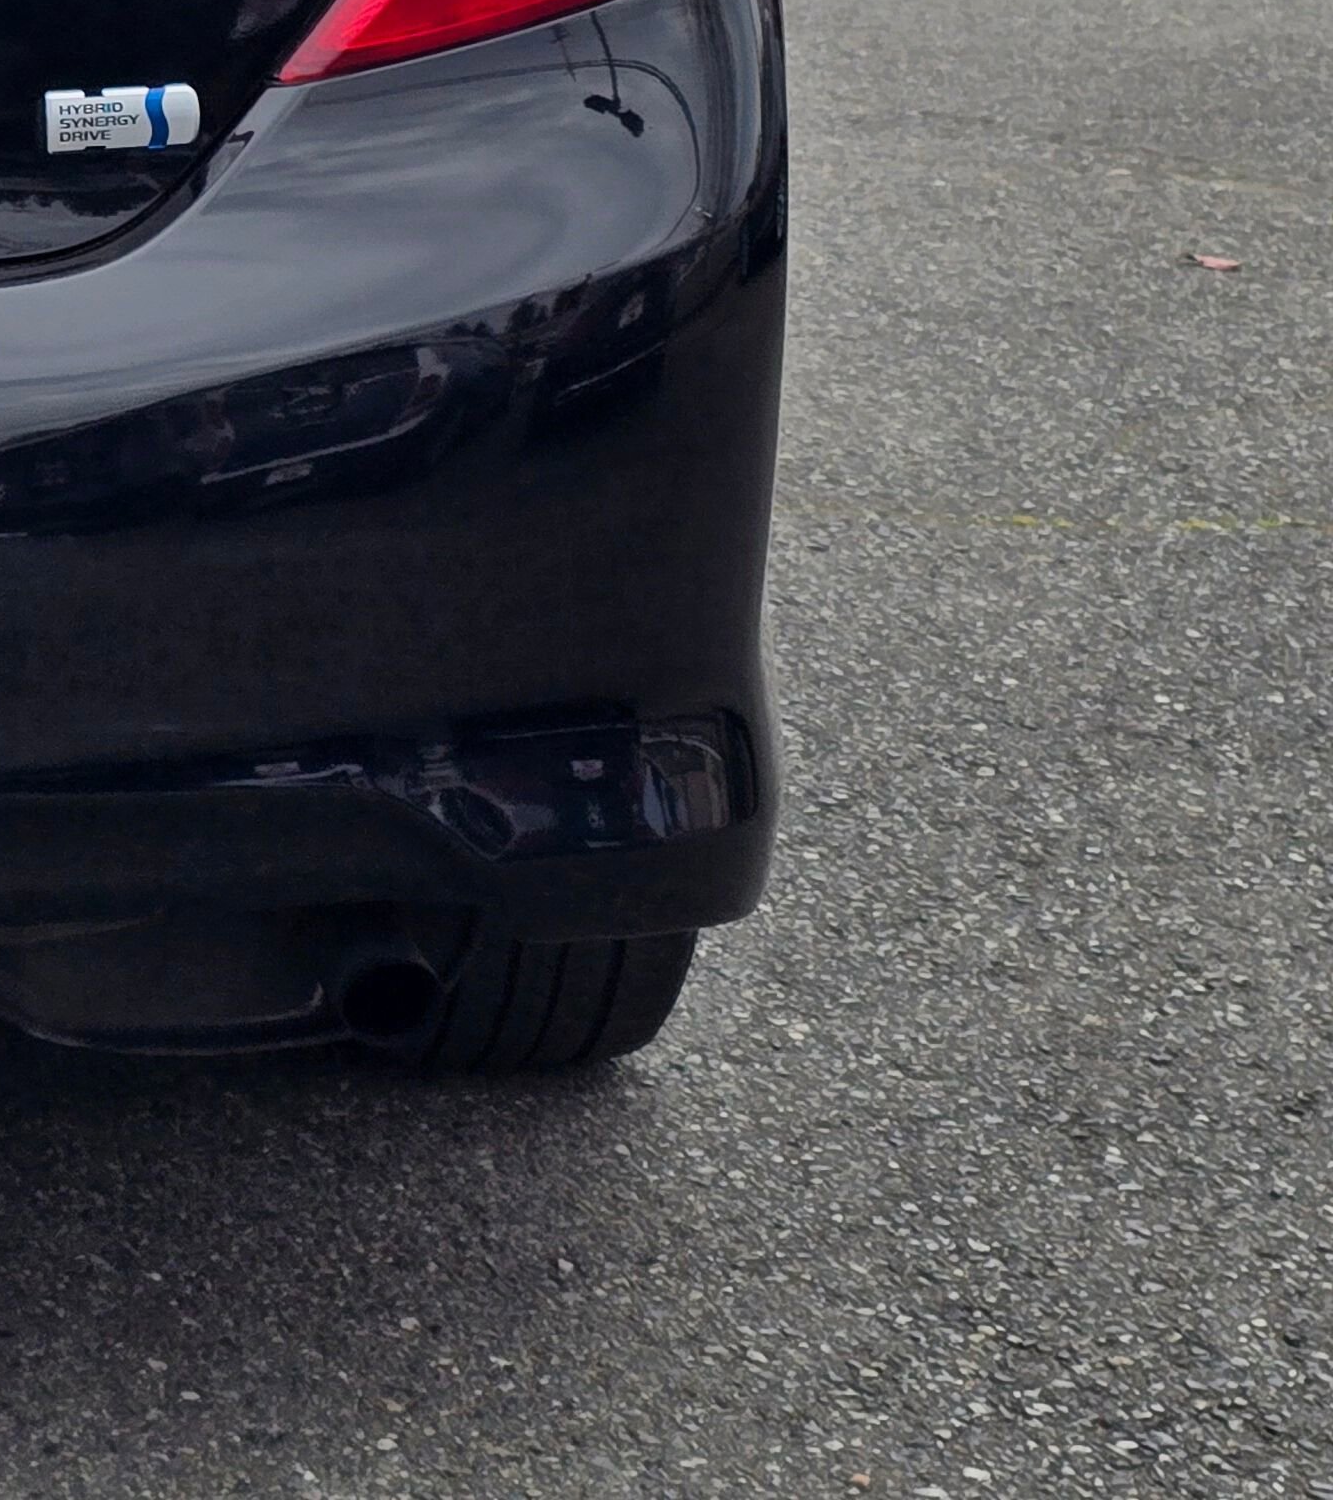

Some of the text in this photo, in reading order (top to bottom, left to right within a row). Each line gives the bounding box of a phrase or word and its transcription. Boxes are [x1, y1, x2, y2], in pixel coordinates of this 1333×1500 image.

[59, 102, 123, 115] HYBRID
[59, 114, 140, 129] SYNERGY
[59, 130, 112, 142] DRIVE
